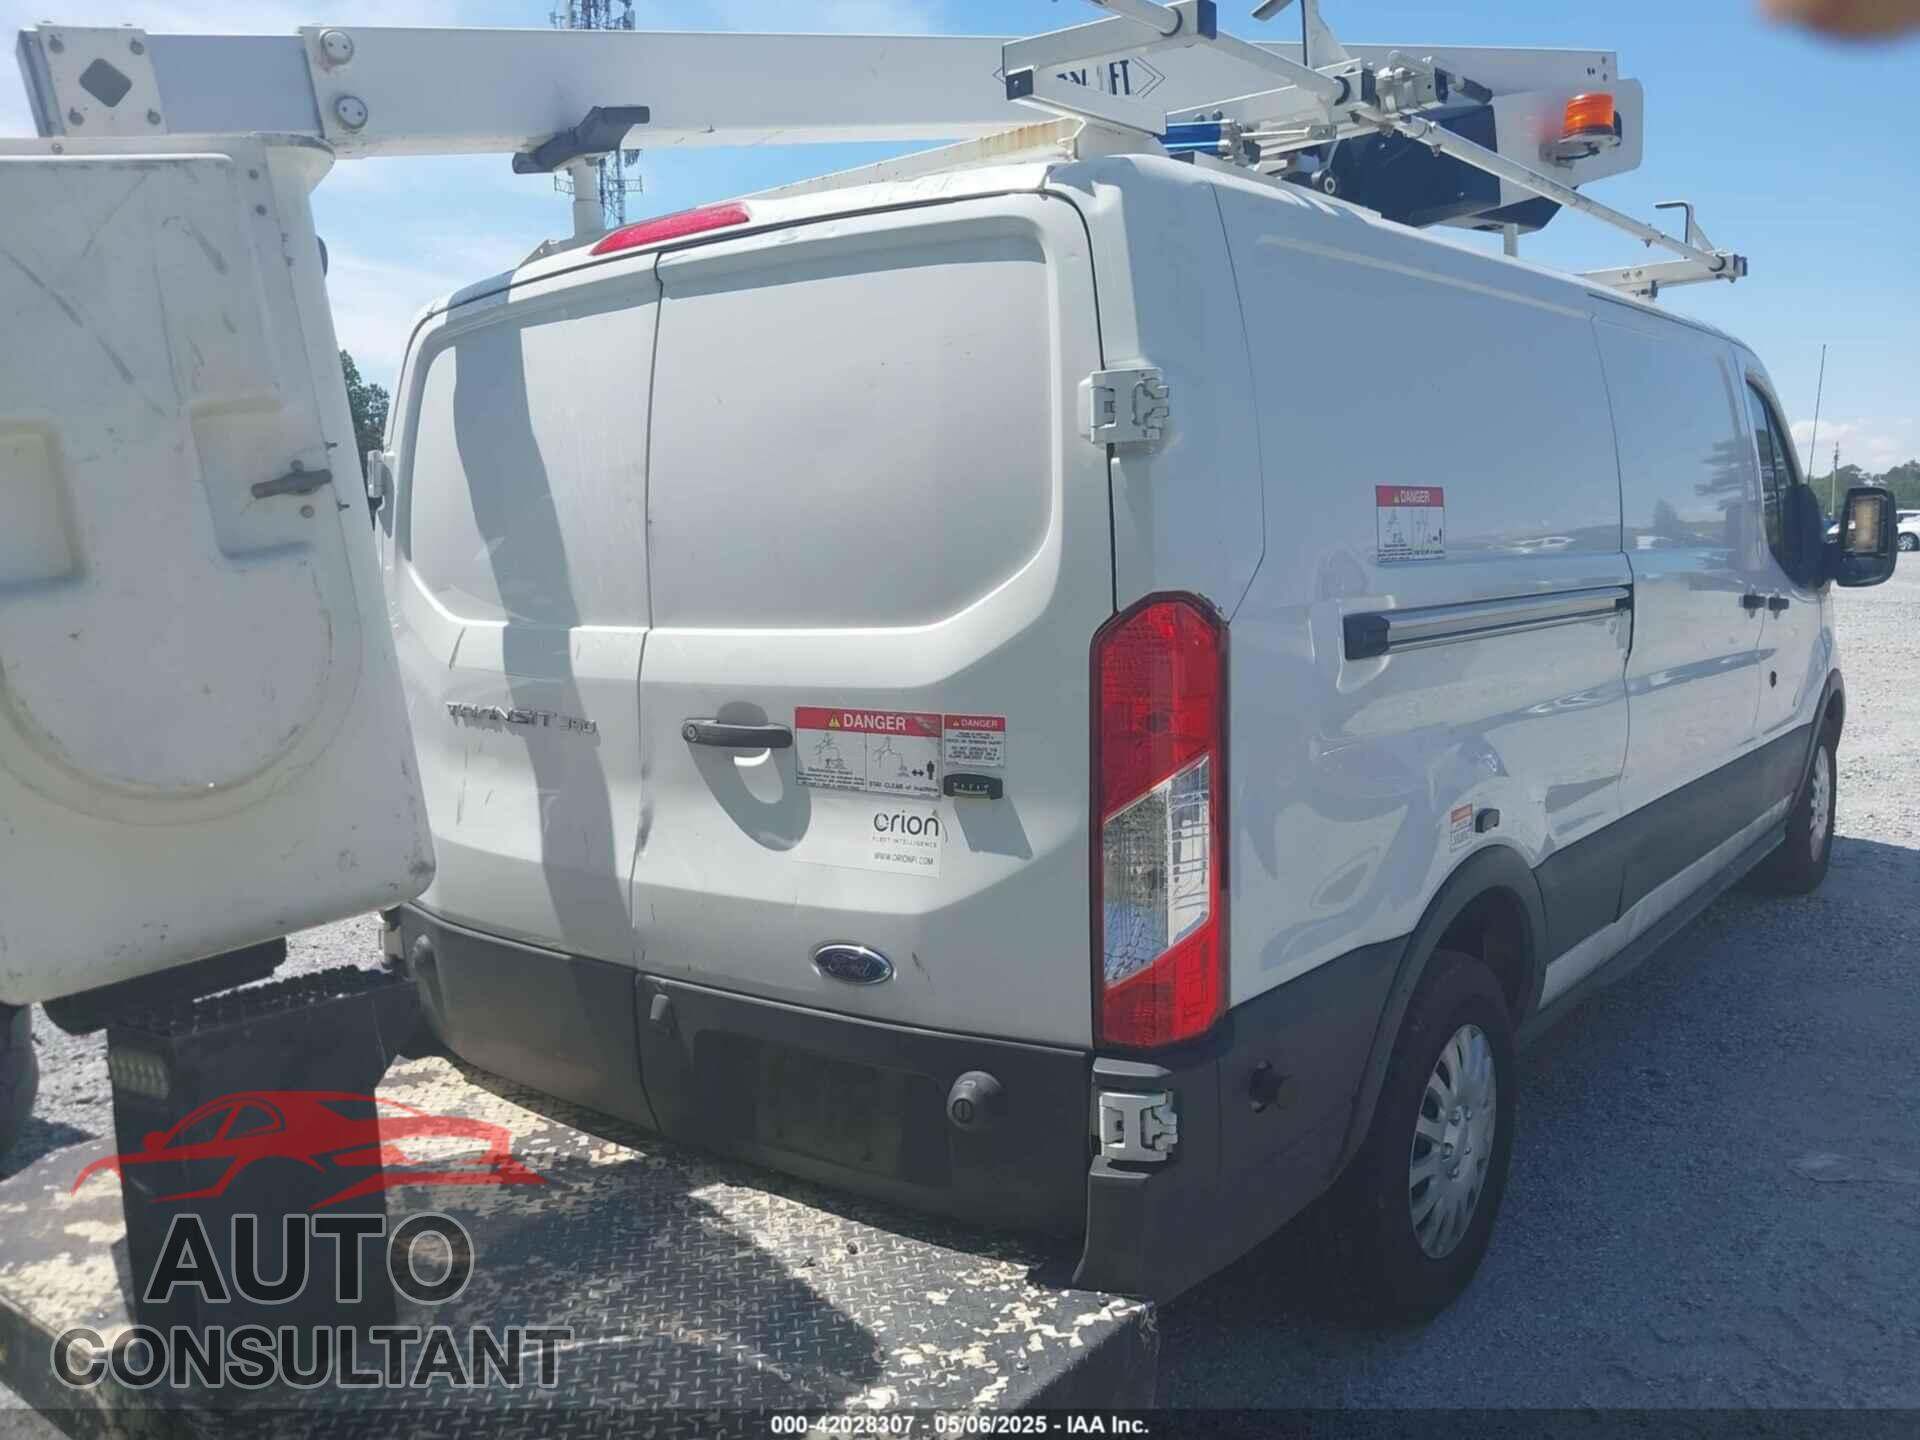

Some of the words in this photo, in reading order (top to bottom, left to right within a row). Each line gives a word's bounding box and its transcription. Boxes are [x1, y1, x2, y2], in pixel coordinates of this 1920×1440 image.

[446, 701, 557, 727] TRANSIT
[844, 713, 906, 731] DANGER
[961, 719, 998, 729] DANGER
[874, 809, 939, 836] orion
